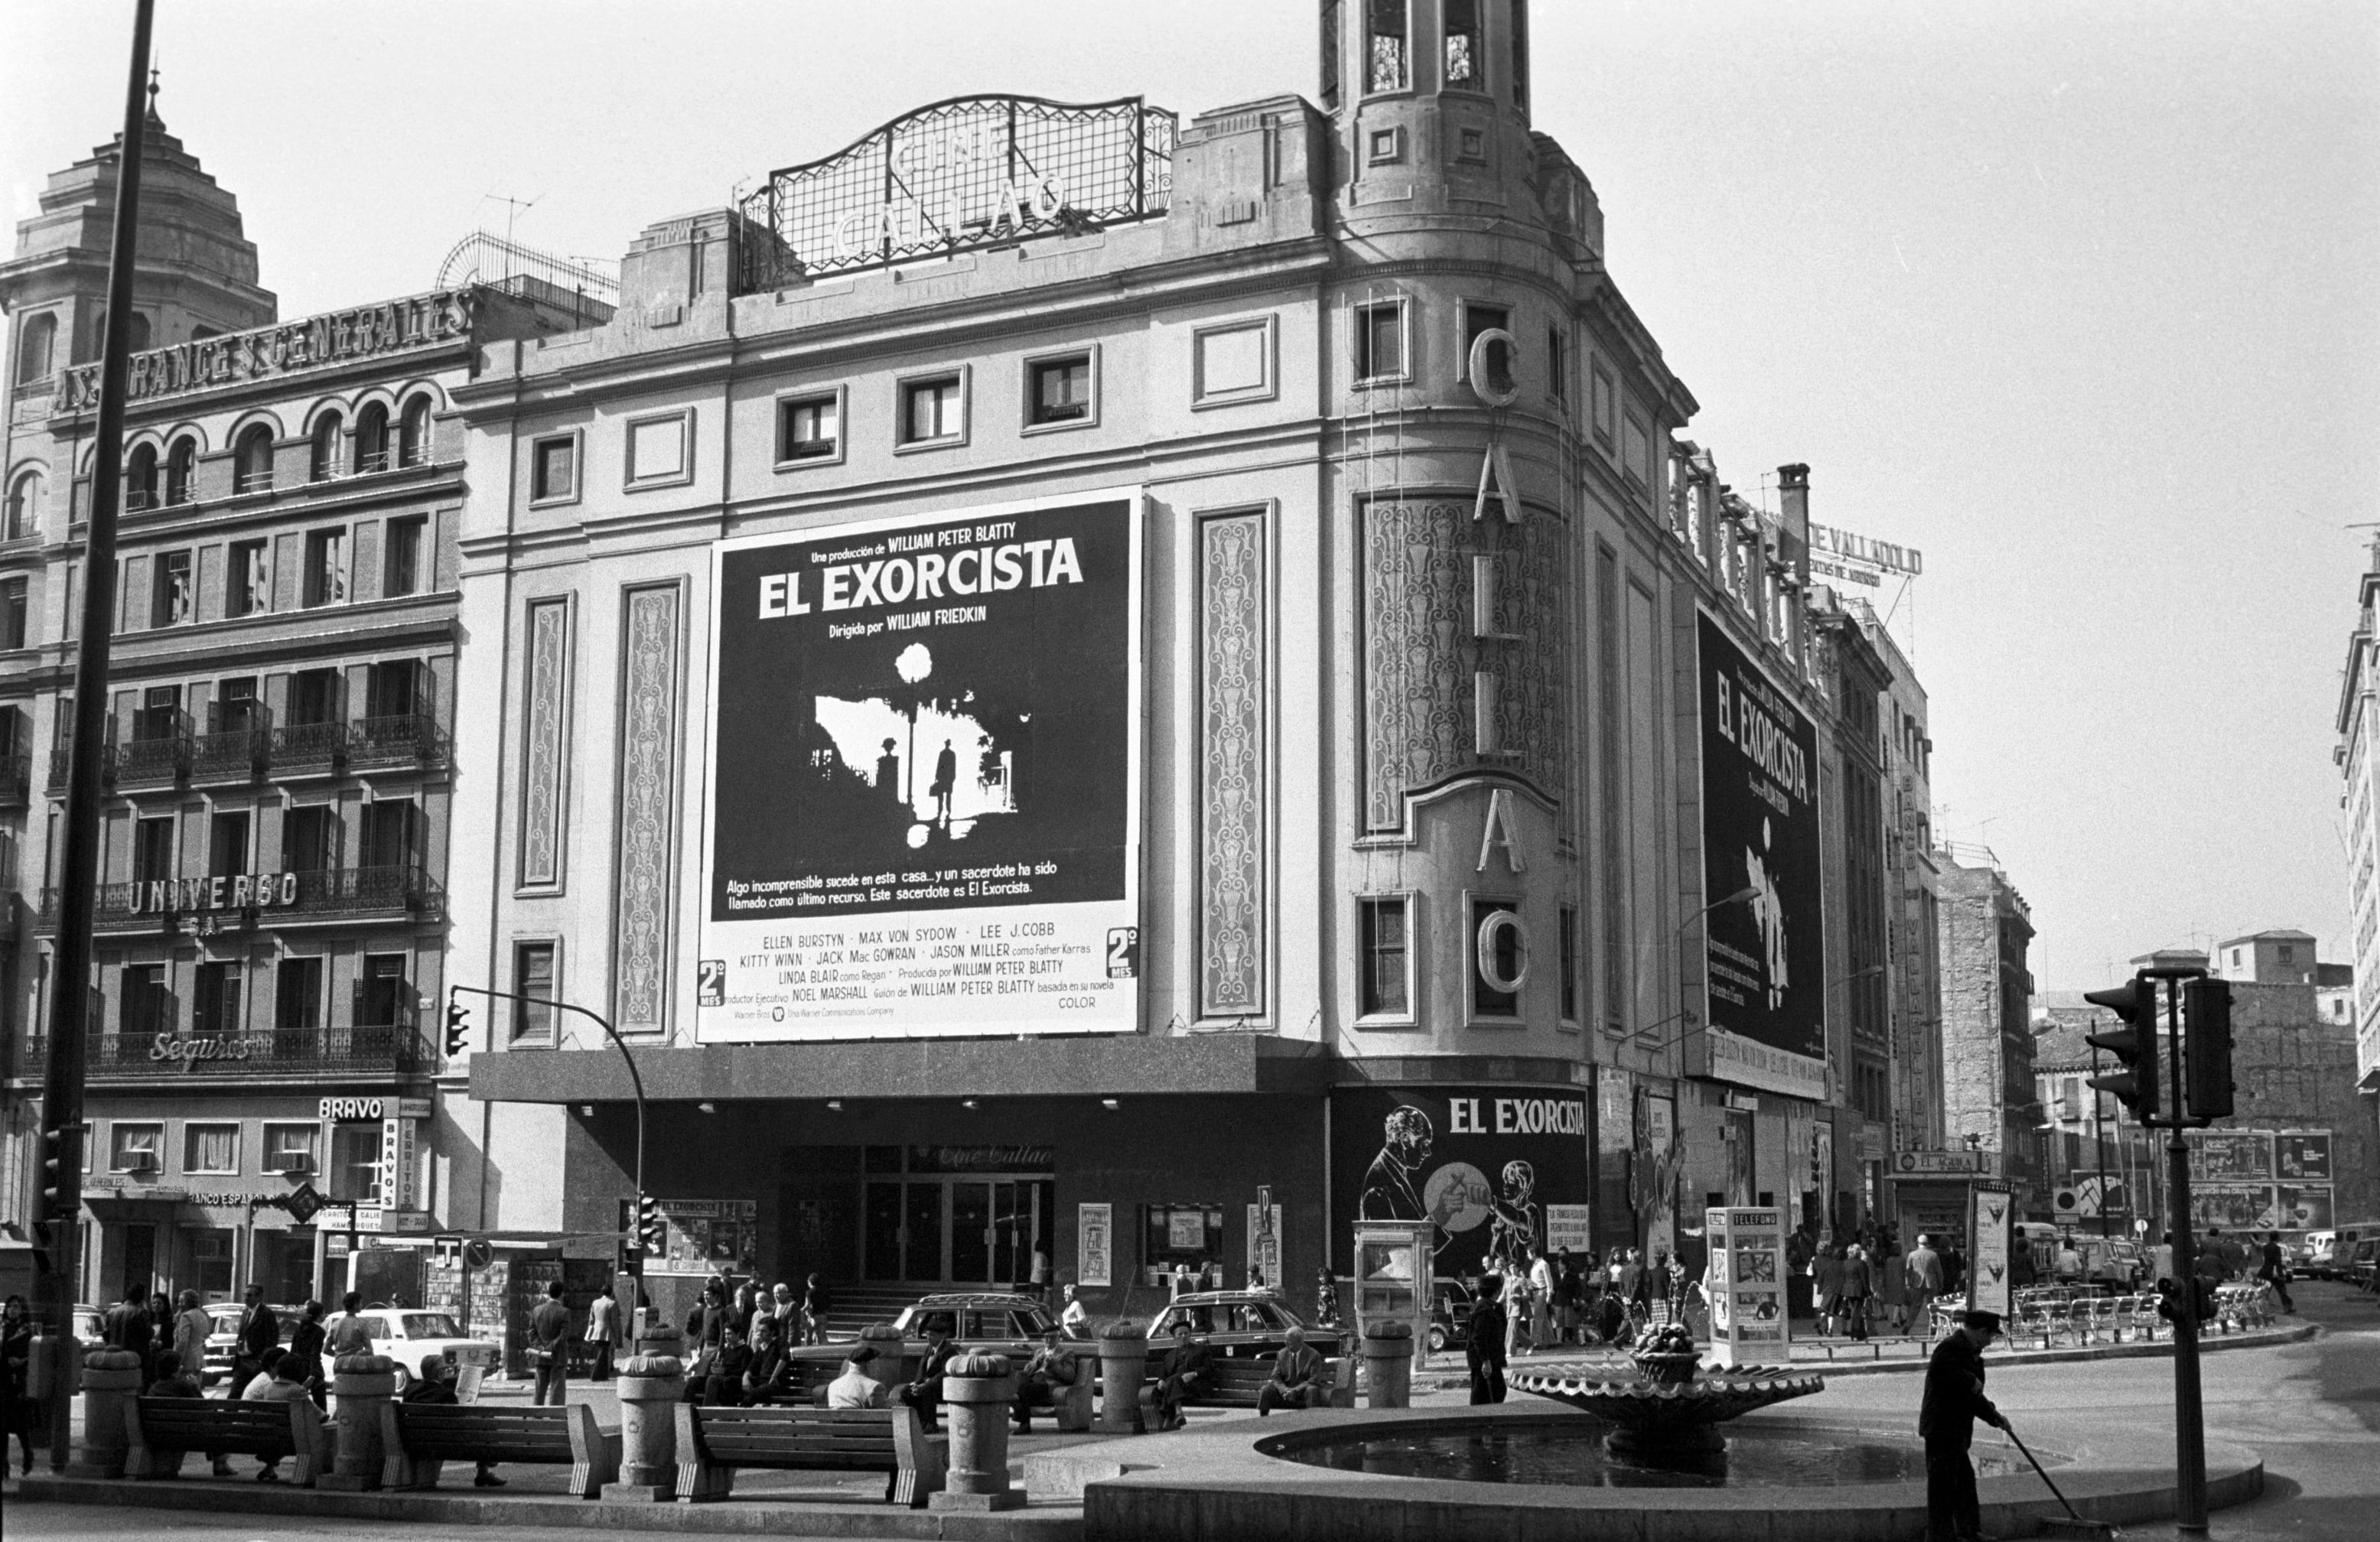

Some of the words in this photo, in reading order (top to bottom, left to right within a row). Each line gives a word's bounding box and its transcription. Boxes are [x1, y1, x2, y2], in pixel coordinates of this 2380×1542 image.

[888, 121, 1011, 176] CINE
[834, 172, 1066, 258] CALLAO
[829, 545, 874, 564] producción
[875, 544, 885, 555] de
[888, 533, 933, 553] WILLIAM
[938, 527, 972, 547] PETER
[975, 522, 1016, 542] BLATTY
[759, 571, 810, 620] EL
[822, 538, 1083, 611] EXORCISTA
[829, 622, 865, 639] Dirigida
[867, 623, 884, 636] por
[887, 610, 930, 631] WILLIAM
[935, 605, 986, 626] FRIEDKIN
[1469, 327, 1530, 994] CALLAO
[1717, 669, 1735, 744] EL
[1740, 691, 1808, 805] EXORCISTA
[127, 872, 298, 914] UNIVERSO
[727, 880, 749, 896] Algo
[752, 874, 822, 893] incomprensible
[826, 873, 859, 888] sucede
[861, 876, 872, 886] en
[875, 871, 896, 884] esta
[944, 869, 958, 880] un
[962, 864, 1015, 880] sacerdote
[1018, 862, 1030, 876] ha
[1034, 860, 1057, 875] sido
[729, 896, 766, 909] llamado
[769, 896, 793, 908] como
[797, 892, 825, 906] último
[829, 893, 867, 904] recurso.
[871, 888, 891, 902] Este
[896, 885, 949, 900] sacerdote
[953, 886, 965, 896] es
[969, 882, 978, 896] El
[982, 880, 1033, 896] Exorcista.
[763, 935, 793, 949] ELLEN
[799, 934, 845, 948] BURSTYN
[858, 932, 883, 945] MAX
[888, 929, 910, 943] VON
[916, 927, 956, 942] SYDOW
[981, 925, 1001, 939] LEE
[740, 955, 770, 968] KITTY
[774, 953, 803, 967] WINN
[816, 951, 843, 965] JACK
[849, 949, 870, 964] Mac
[873, 947, 916, 962] GOWRAN
[930, 945, 965, 959] JASON
[970, 943, 1010, 957] MILLER
[1012, 946, 1034, 955] como
[1035, 944, 1060, 955] Father
[1062, 942, 1091, 955] Karras
[779, 971, 806, 985] LINDA
[810, 969, 838, 984] BLAIR
[839, 972, 859, 982] como
[861, 970, 886, 982] Regan
[898, 967, 937, 980] Producida
[939, 969, 952, 981] por
[952, 961, 991, 977] WILLIAM
[995, 960, 1024, 975] PETER
[1030, 959, 1063, 974] BLATTY
[1112, 967, 1131, 978] MES
[701, 996, 721, 1007] MES
[724, 995, 754, 1004] roductor
[756, 994, 789, 1006] Ejecutivo
[793, 989, 816, 1002] NOEL
[820, 986, 868, 1001] MARSHALL
[897, 987, 907, 997] de
[910, 982, 956, 997] WILLIAM
[961, 981, 993, 995] PETER
[998, 979, 1035, 994] BLATTY
[1037, 981, 1067, 993] basada
[1070, 982, 1079, 992] en
[1080, 982, 1089, 991] su
[1090, 981, 1114, 991] novela
[1059, 997, 1096, 1008] COLOR
[149, 1033, 257, 1072] Seguros
[1448, 1098, 1487, 1134] EL
[1494, 1098, 1586, 1136] EXORCISTA
[187, 1193, 219, 1205] BANCO
[1735, 1214, 1776, 1225] TELEFONO
